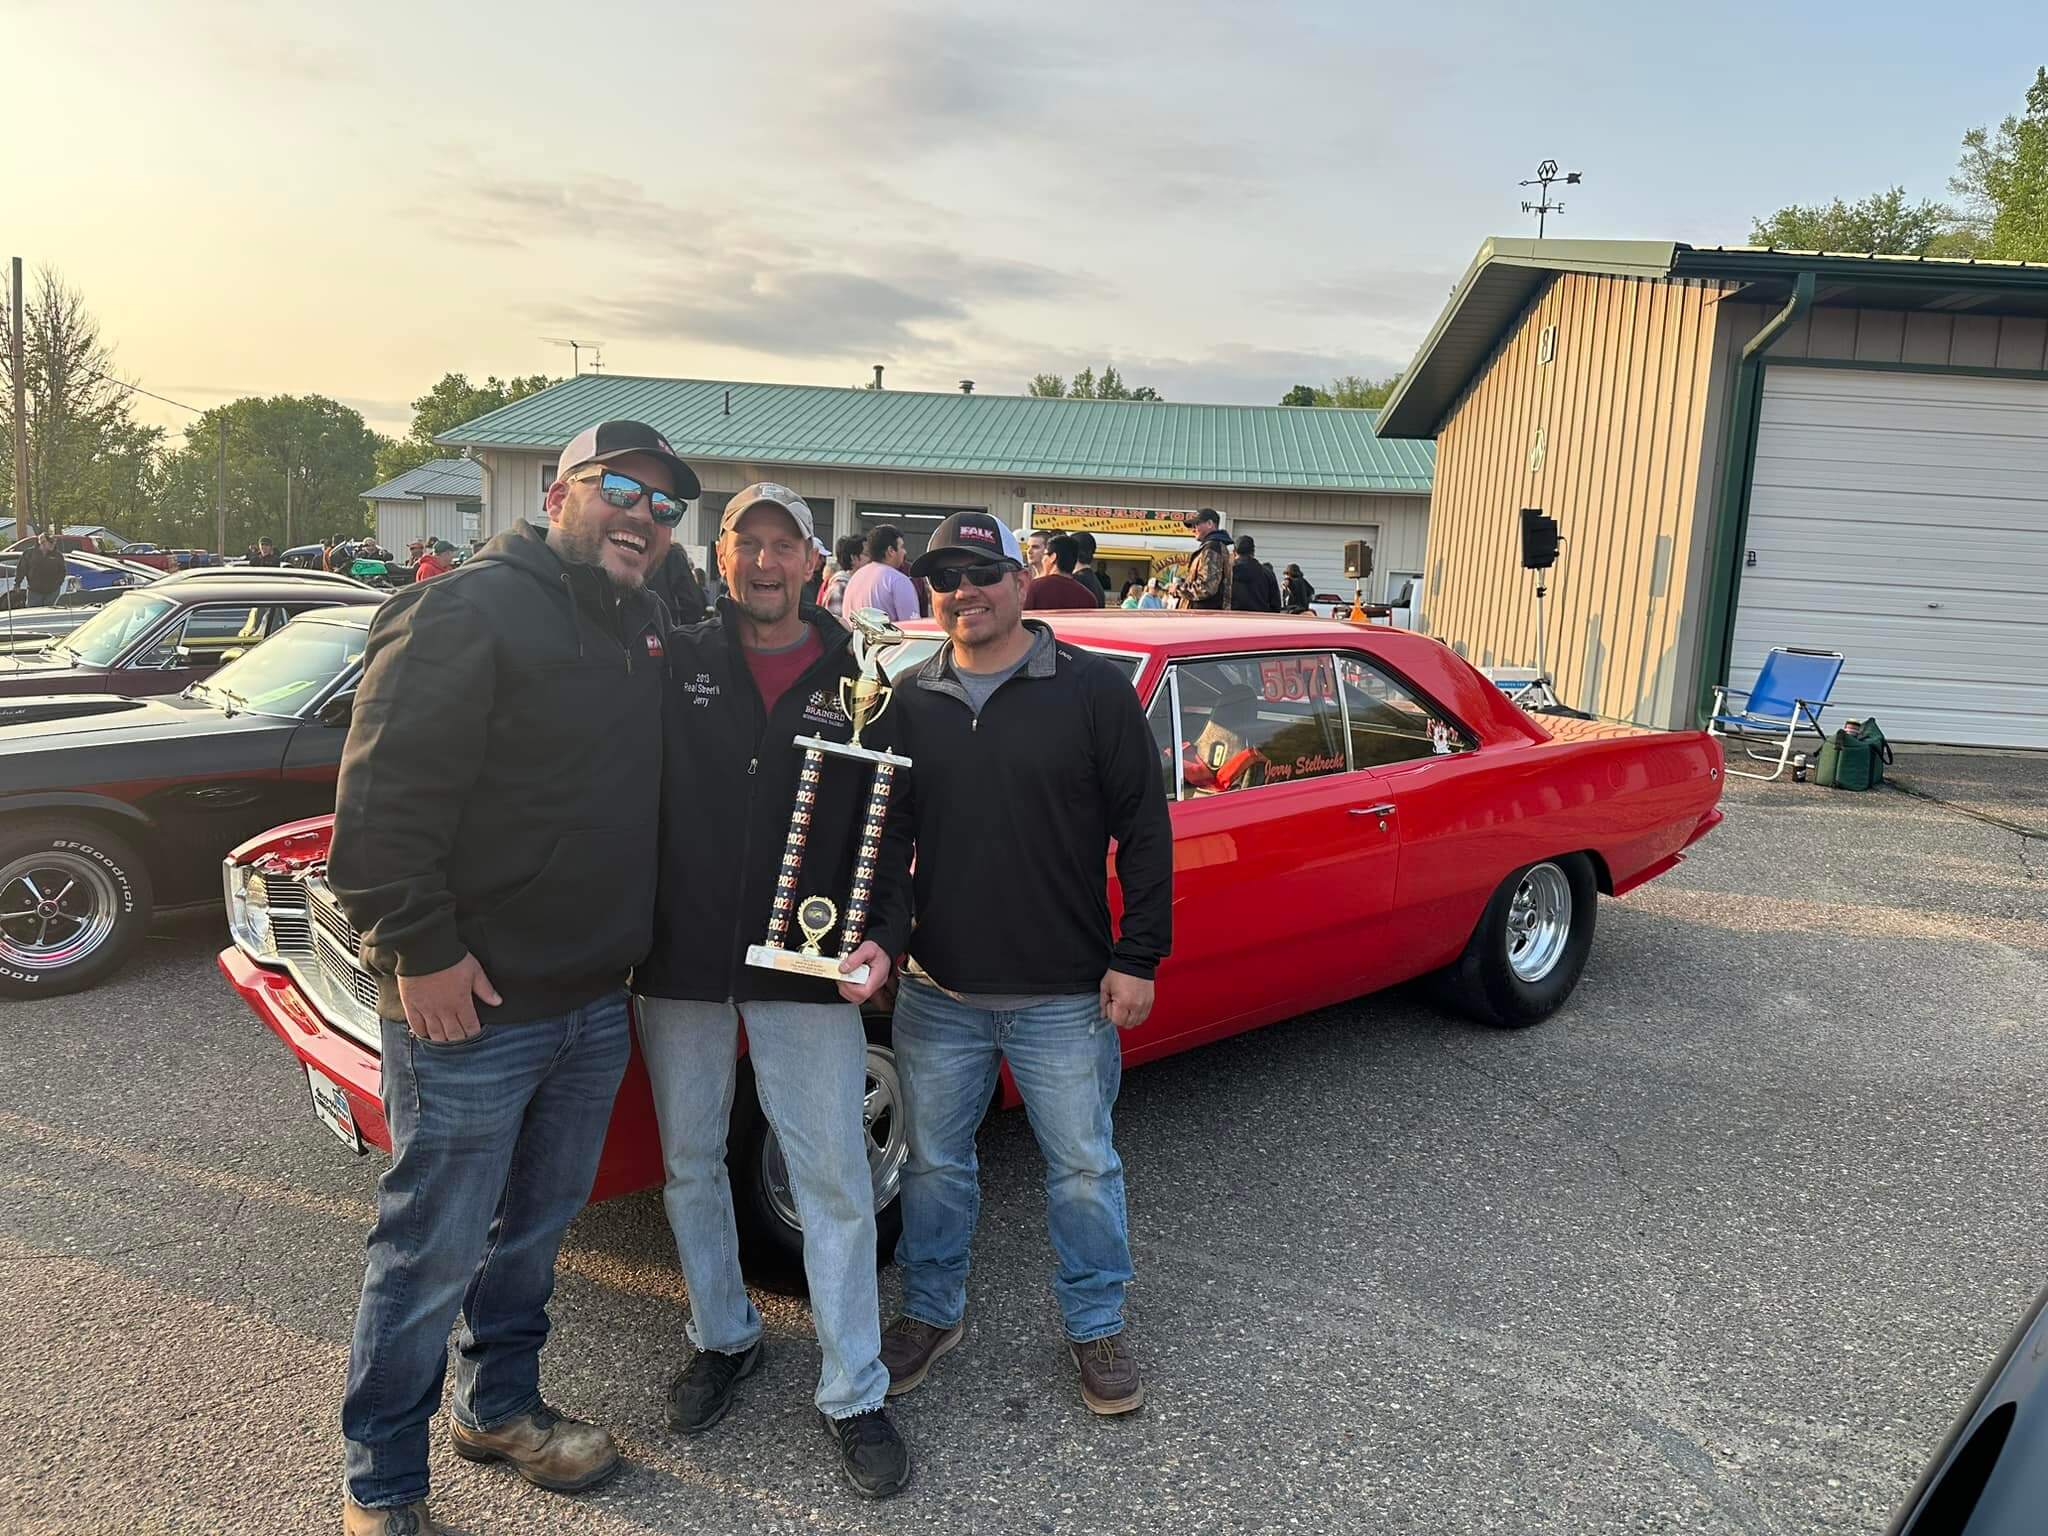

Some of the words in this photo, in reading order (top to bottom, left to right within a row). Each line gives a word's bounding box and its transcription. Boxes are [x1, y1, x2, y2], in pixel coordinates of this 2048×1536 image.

[1033, 505, 1146, 519] MEXICAN
[960, 526, 995, 540] FALK
[696, 673, 710, 683] 2013
[697, 683, 716, 695] Street
[693, 695, 710, 707] Jerry
[805, 705, 845, 721] BRAINERD
[1264, 760, 1291, 784] Jerry
[1296, 753, 1345, 776] Stellrecht
[52, 840, 134, 913] BFGoodrich
